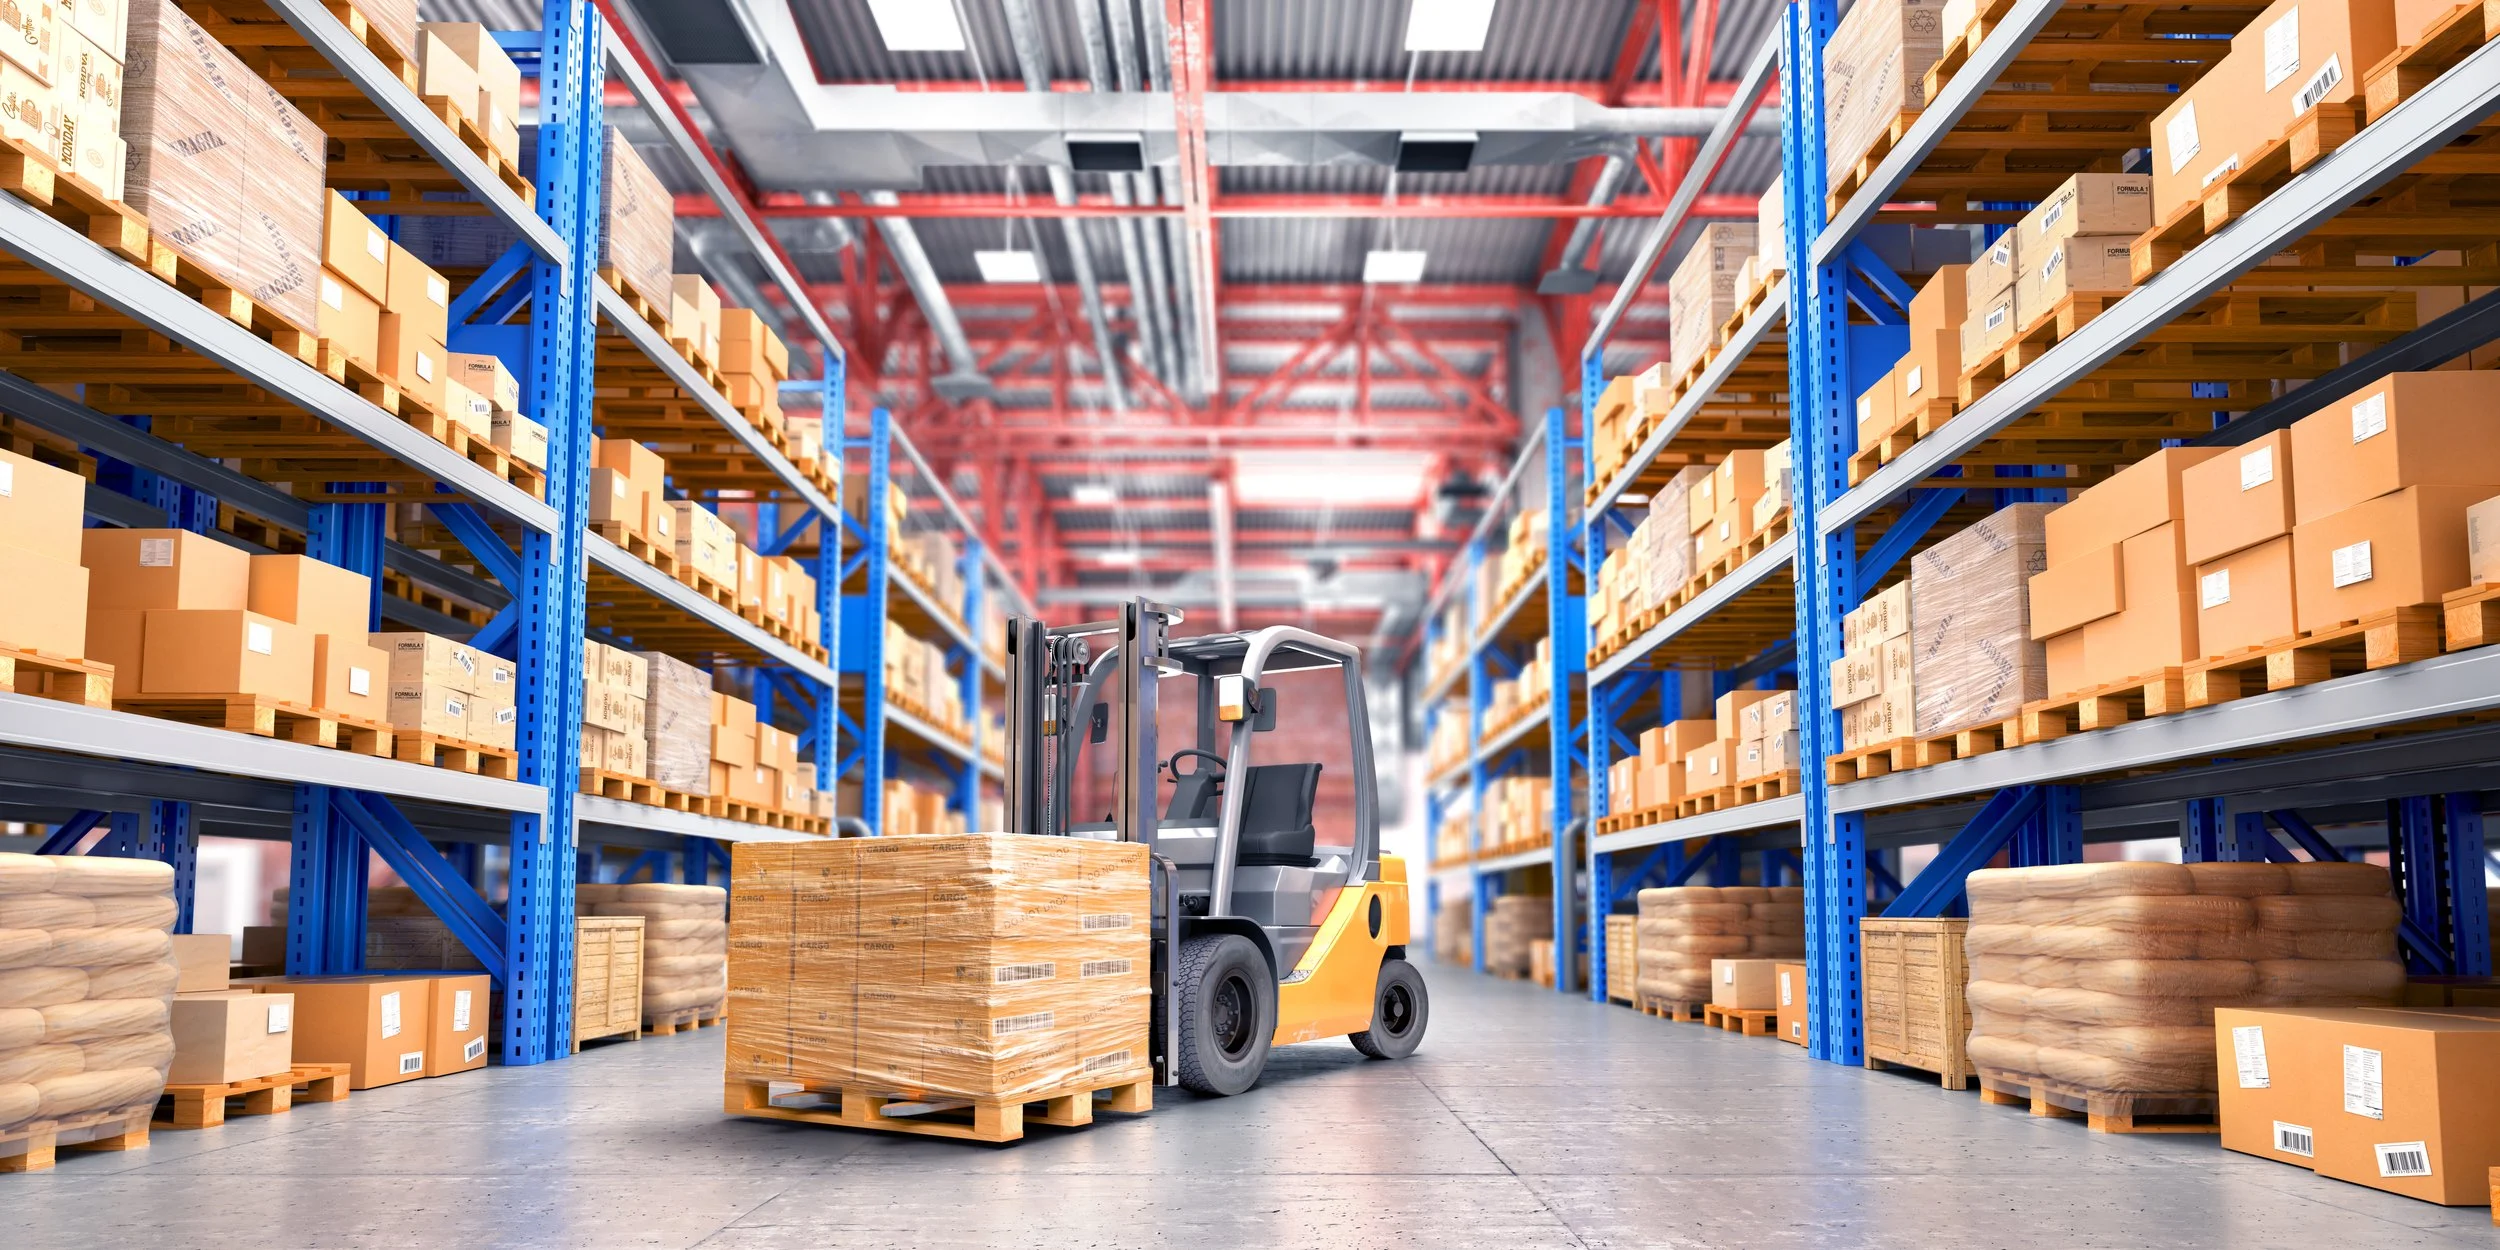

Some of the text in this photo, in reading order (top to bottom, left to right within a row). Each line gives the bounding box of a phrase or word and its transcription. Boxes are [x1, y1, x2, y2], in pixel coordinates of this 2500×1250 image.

[61, 114, 75, 167] MONDAY
[866, 845, 899, 853] CARGO
[932, 843, 965, 852] CARGO
[735, 895, 765, 903] CARGO
[932, 893, 968, 902] CARGO
[734, 941, 763, 949] CARGO
[863, 943, 895, 951] CARGO
